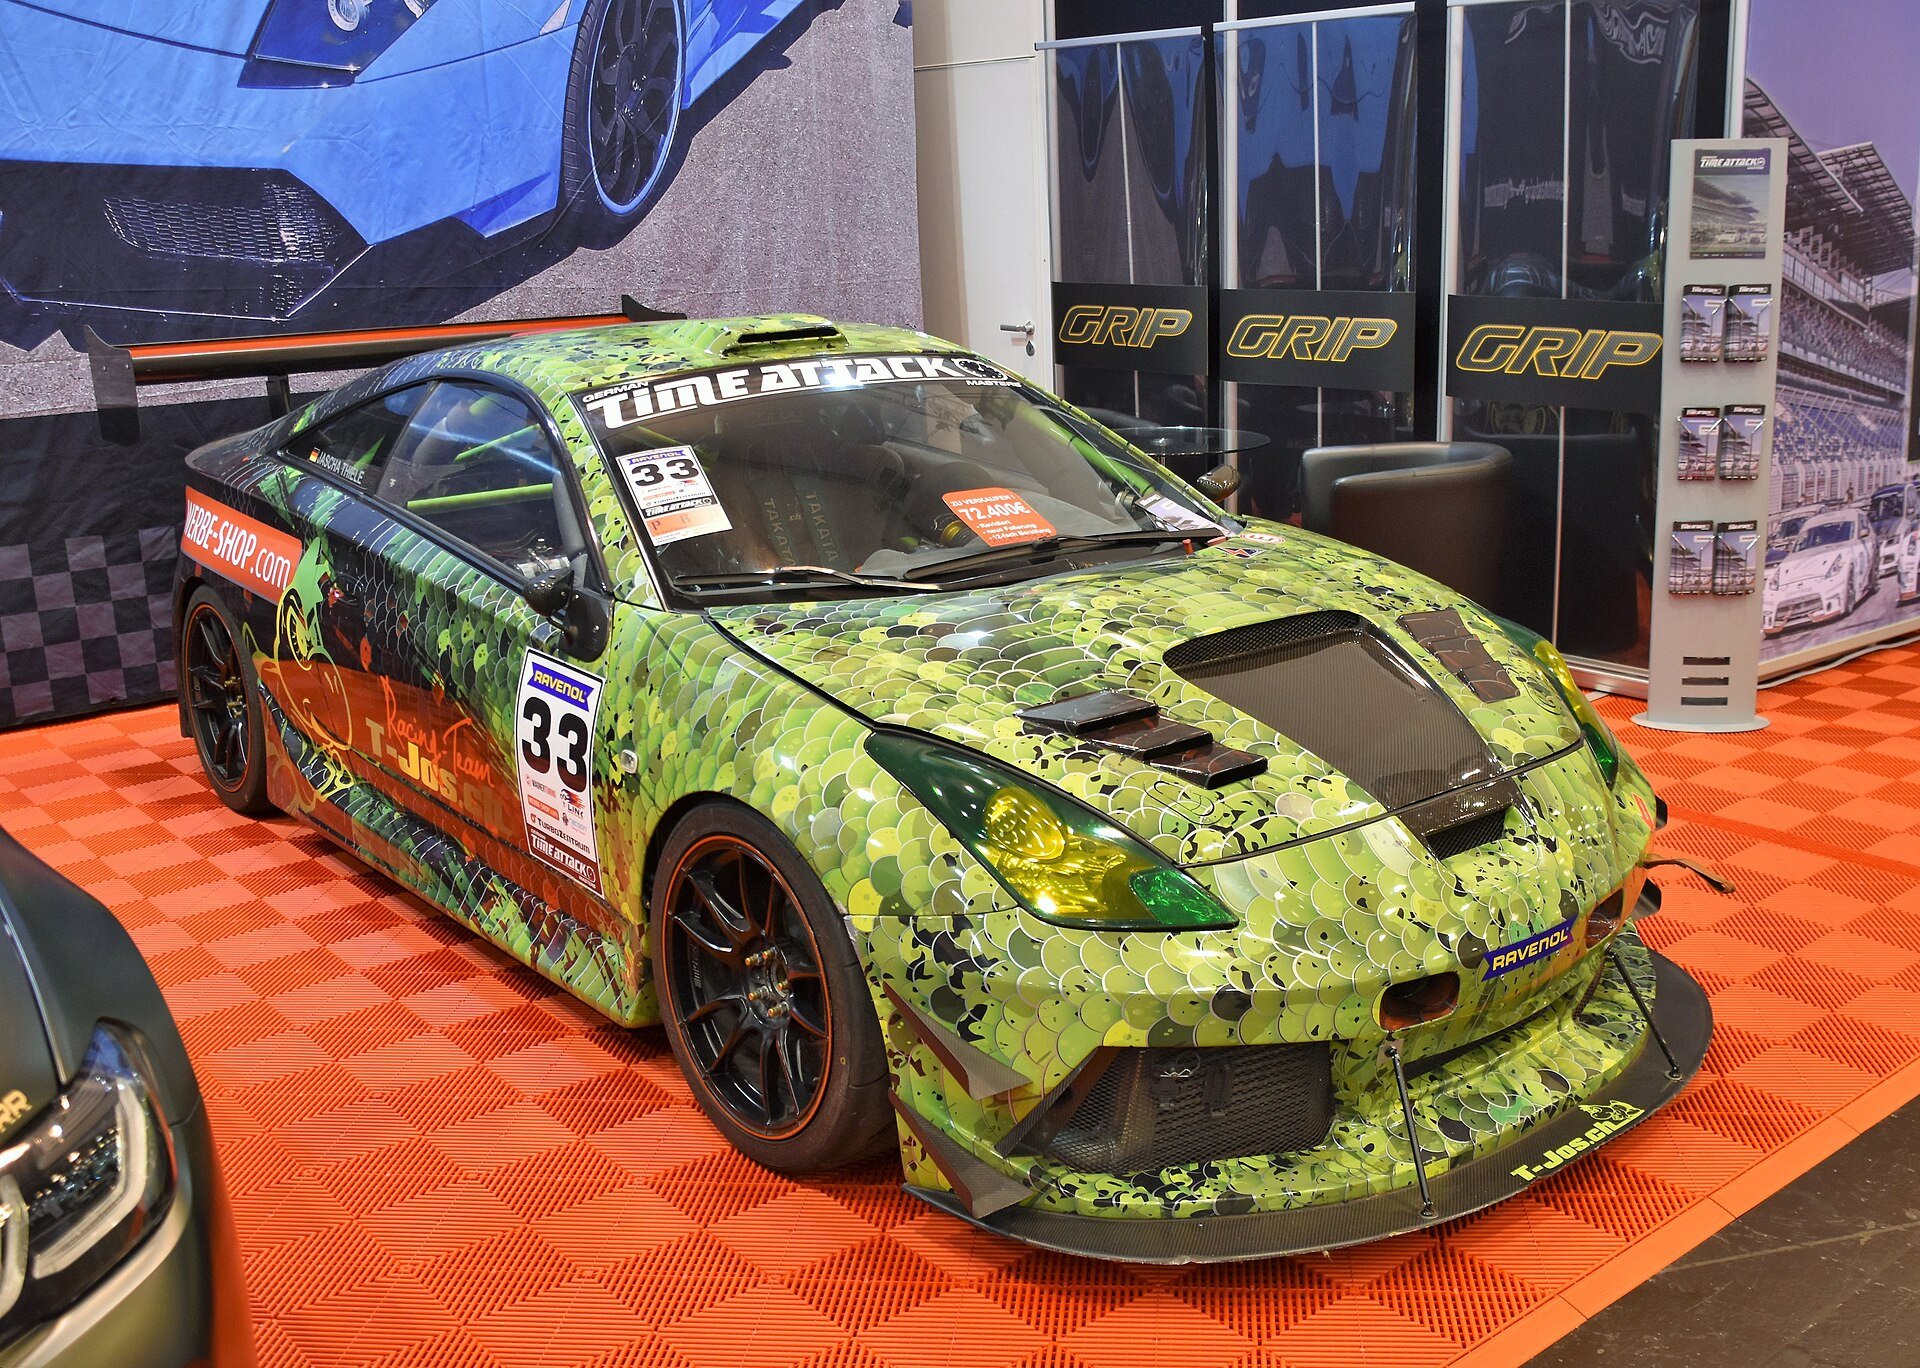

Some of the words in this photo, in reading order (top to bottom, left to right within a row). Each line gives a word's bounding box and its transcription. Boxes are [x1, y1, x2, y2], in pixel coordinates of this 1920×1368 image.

[1058, 305, 1193, 349] GRIP
[1226, 314, 1398, 362] GRIP
[1456, 324, 1664, 380] GRIP
[760, 356, 964, 392] ATTACK
[965, 380, 1022, 389] MASTERS
[582, 381, 650, 403] GERMAN
[317, 452, 341, 473] JASCHA
[341, 462, 365, 485] THIELE
[631, 451, 683, 464] RAVENOL
[631, 458, 699, 487] 33
[958, 501, 1031, 521] 72.400€
[963, 495, 1011, 505] VERKAUFEN
[805, 490, 839, 561] TAKATA
[184, 499, 291, 590] WERBE-SHOP.com
[534, 671, 585, 703] RAVENOL
[522, 697, 589, 793] 33
[1492, 930, 1569, 971] RAVENOL
